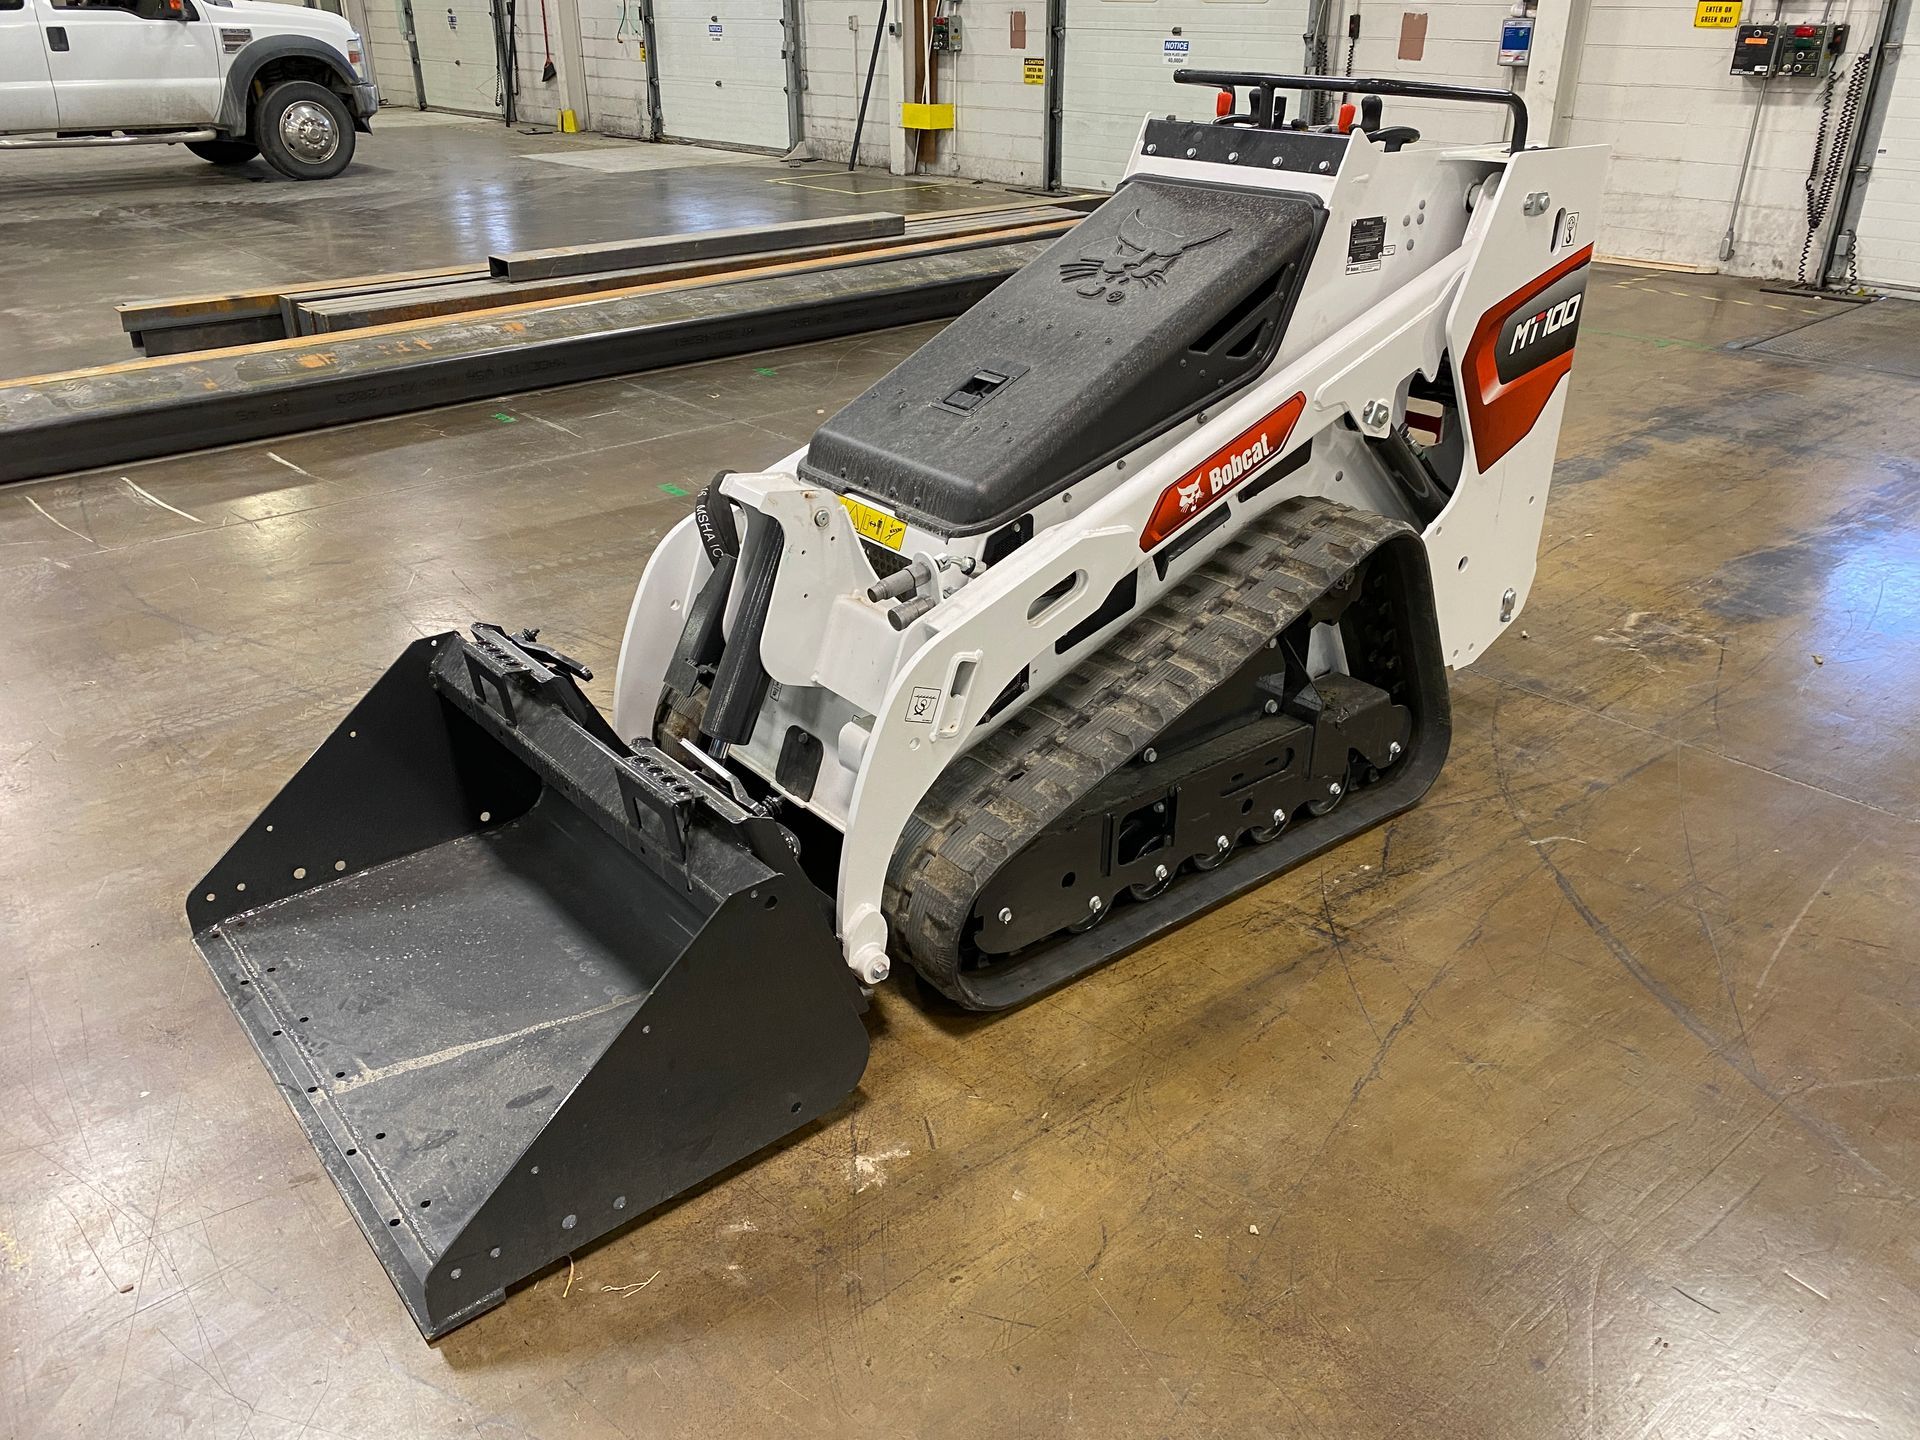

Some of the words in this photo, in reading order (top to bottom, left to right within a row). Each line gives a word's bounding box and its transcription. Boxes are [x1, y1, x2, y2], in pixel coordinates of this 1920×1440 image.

[1165, 41, 1188, 50] NOTICE
[1208, 432, 1270, 495] Bobcat
[696, 504, 715, 542] MSHA
